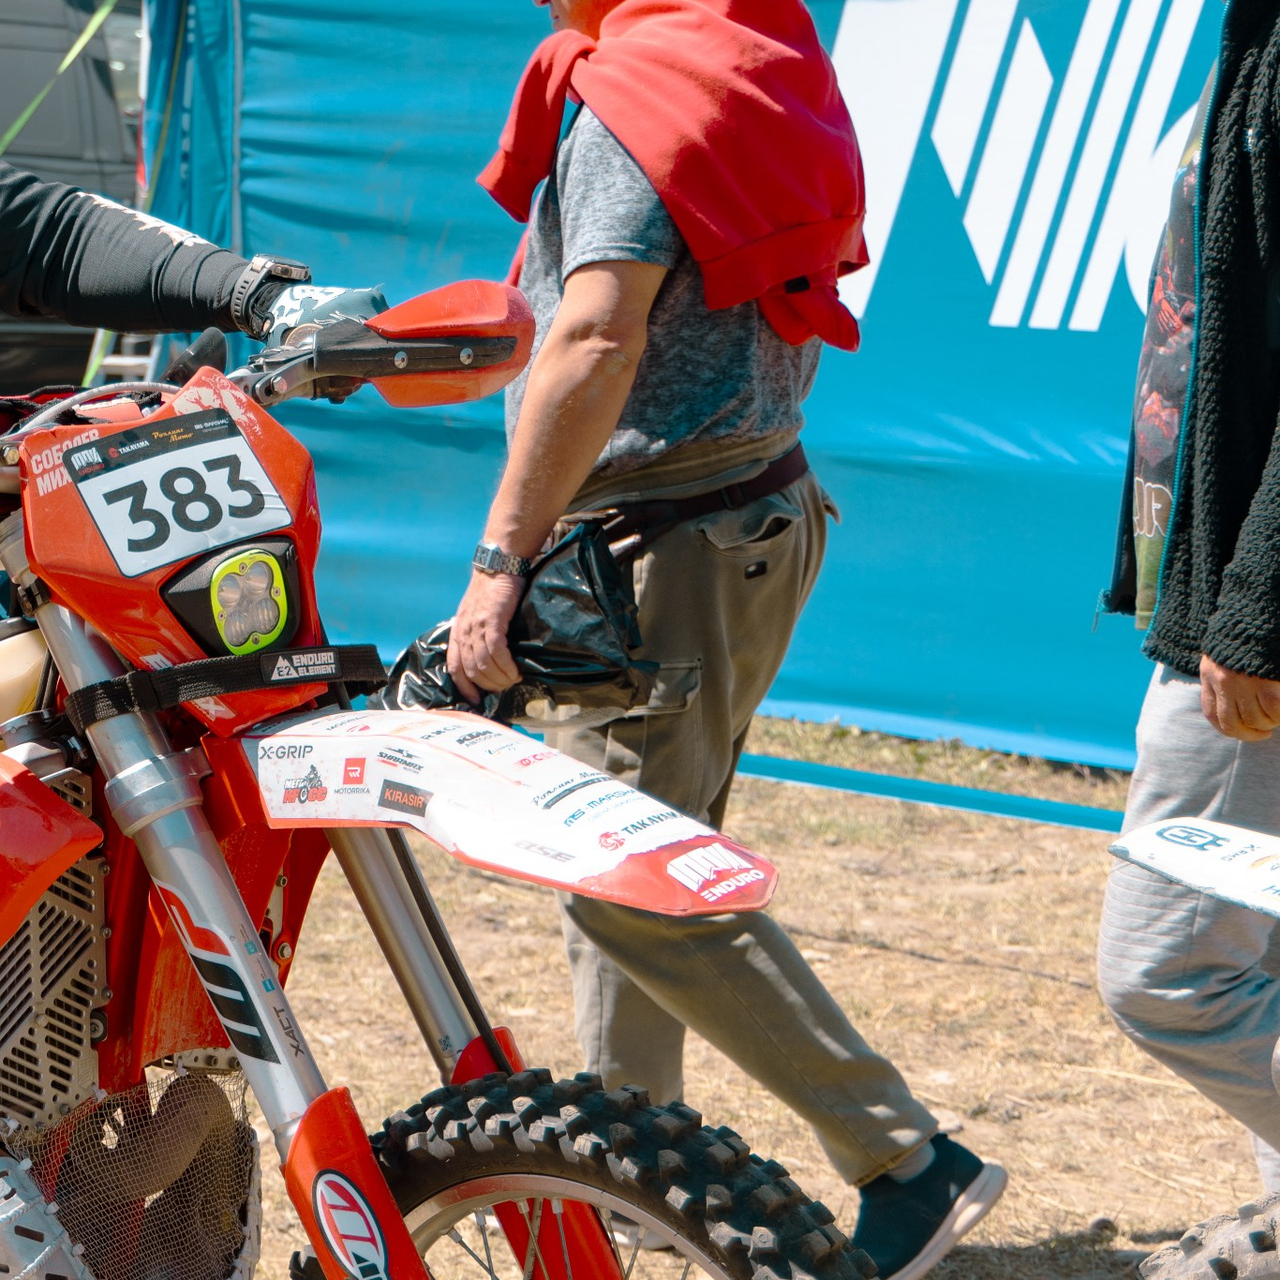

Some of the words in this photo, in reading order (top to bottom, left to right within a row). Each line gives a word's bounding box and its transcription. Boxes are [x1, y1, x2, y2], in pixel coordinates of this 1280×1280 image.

[118, 439, 150, 456] TAKAYAMA
[102, 453, 266, 553] 383
[292, 651, 335, 666] ENDURO
[297, 663, 336, 676] ELEMENT
[259, 745, 314, 760] X-GRIP
[333, 787, 371, 796] MOTORRIKA
[384, 788, 424, 808] KIRASIR
[700, 869, 766, 903] ENDURO
[273, 1005, 306, 1059] XACT
